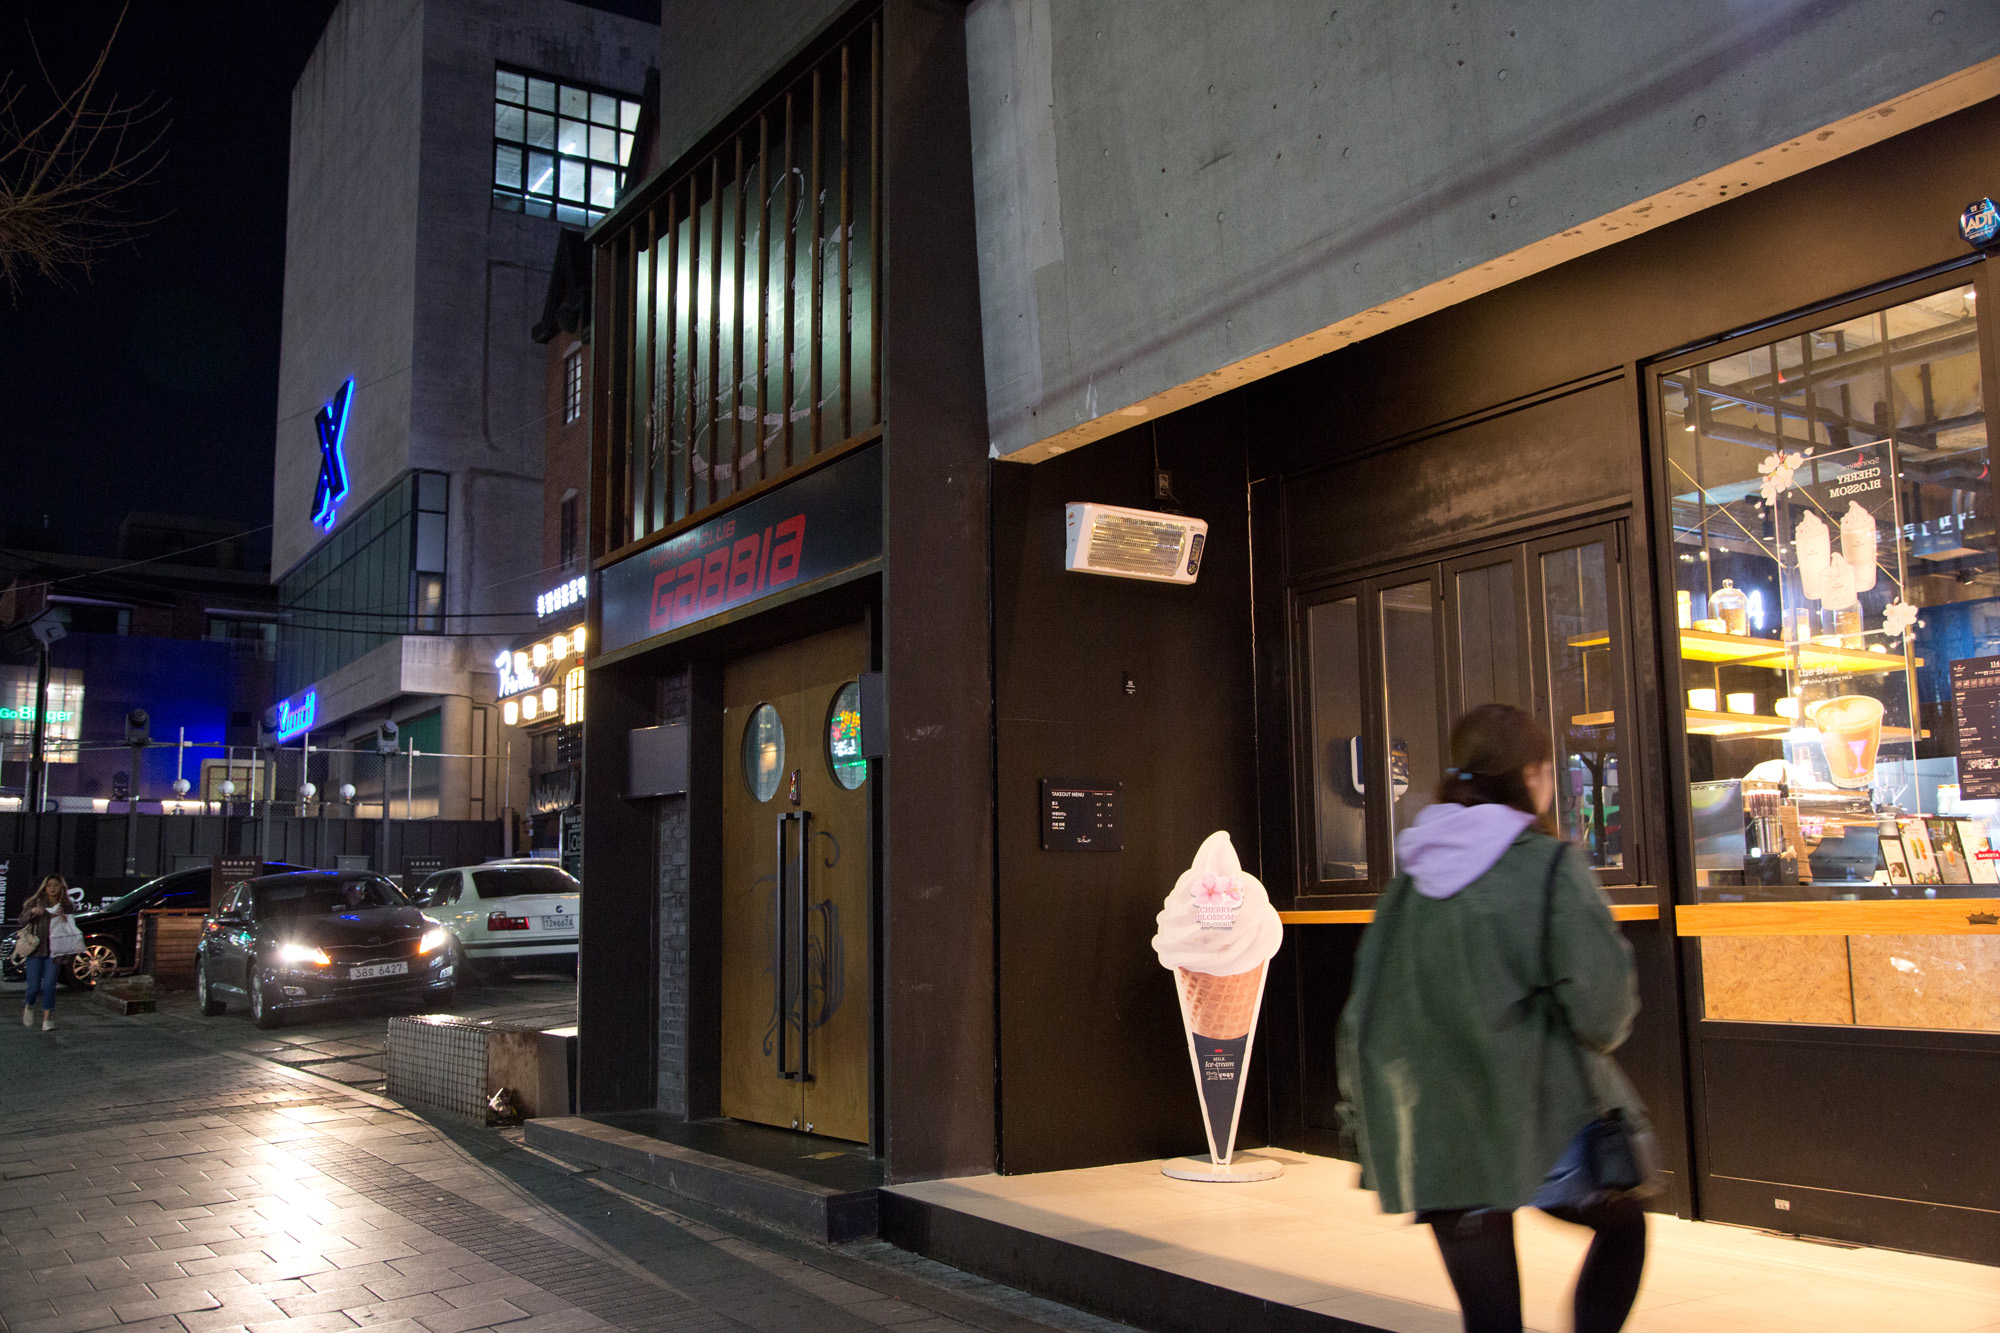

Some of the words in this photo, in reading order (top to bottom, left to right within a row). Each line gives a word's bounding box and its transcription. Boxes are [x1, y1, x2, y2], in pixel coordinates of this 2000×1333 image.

[1966, 210, 1995, 232] ADT
[650, 538, 696, 570] HIPHOP
[699, 519, 736, 549] CLUB
